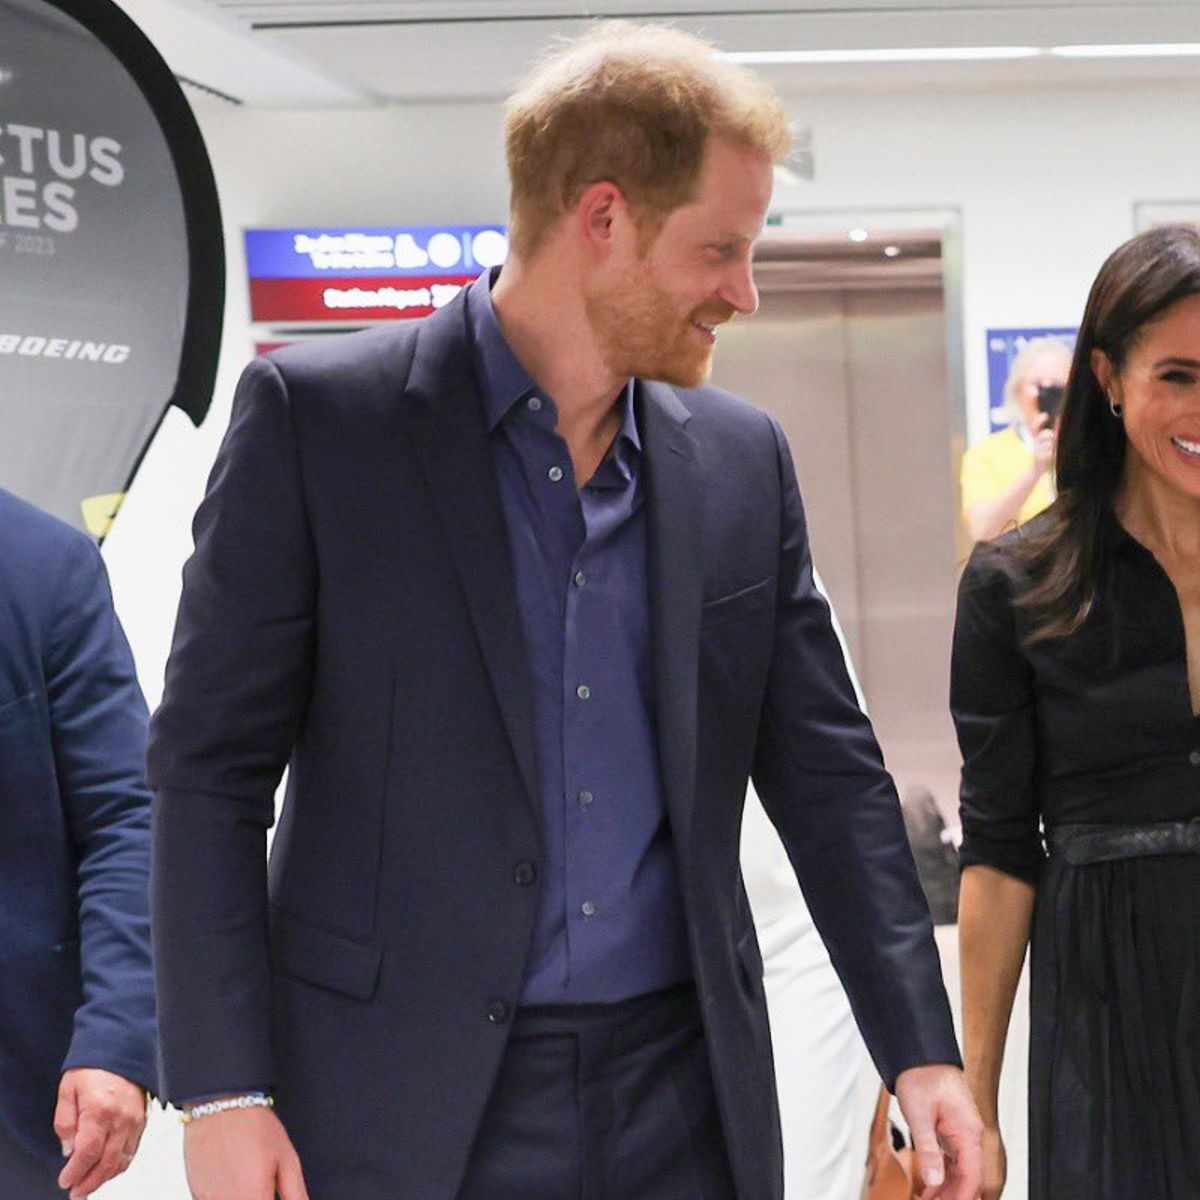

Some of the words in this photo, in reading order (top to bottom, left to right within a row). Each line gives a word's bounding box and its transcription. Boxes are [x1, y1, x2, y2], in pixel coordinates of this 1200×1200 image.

[0, 123, 124, 187] TUS
[0, 176, 79, 232] ES
[0, 334, 131, 364] BOEING
